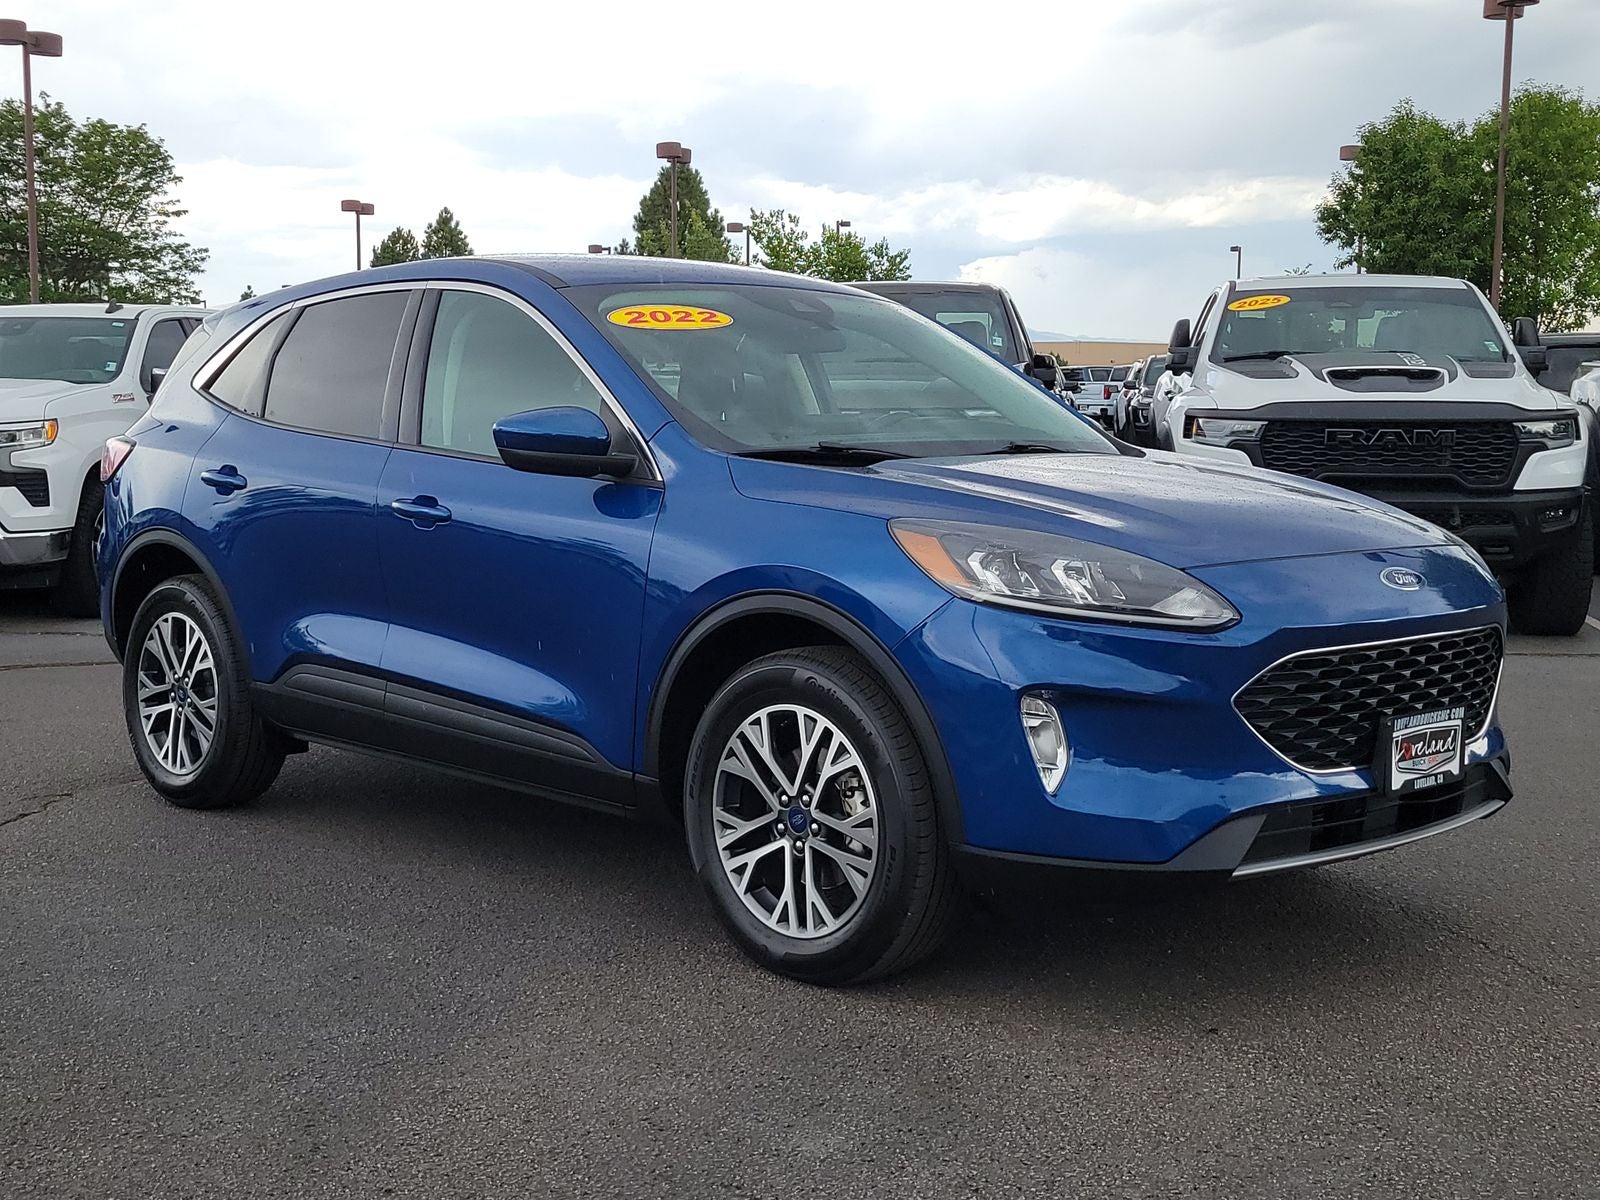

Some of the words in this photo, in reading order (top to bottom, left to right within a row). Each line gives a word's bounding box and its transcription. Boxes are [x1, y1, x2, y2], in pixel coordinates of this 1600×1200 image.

[1235, 296, 1284, 309] 2025
[624, 310, 721, 324] 2022
[1324, 428, 1457, 446] RAM
[1395, 729, 1455, 761] Loveland
